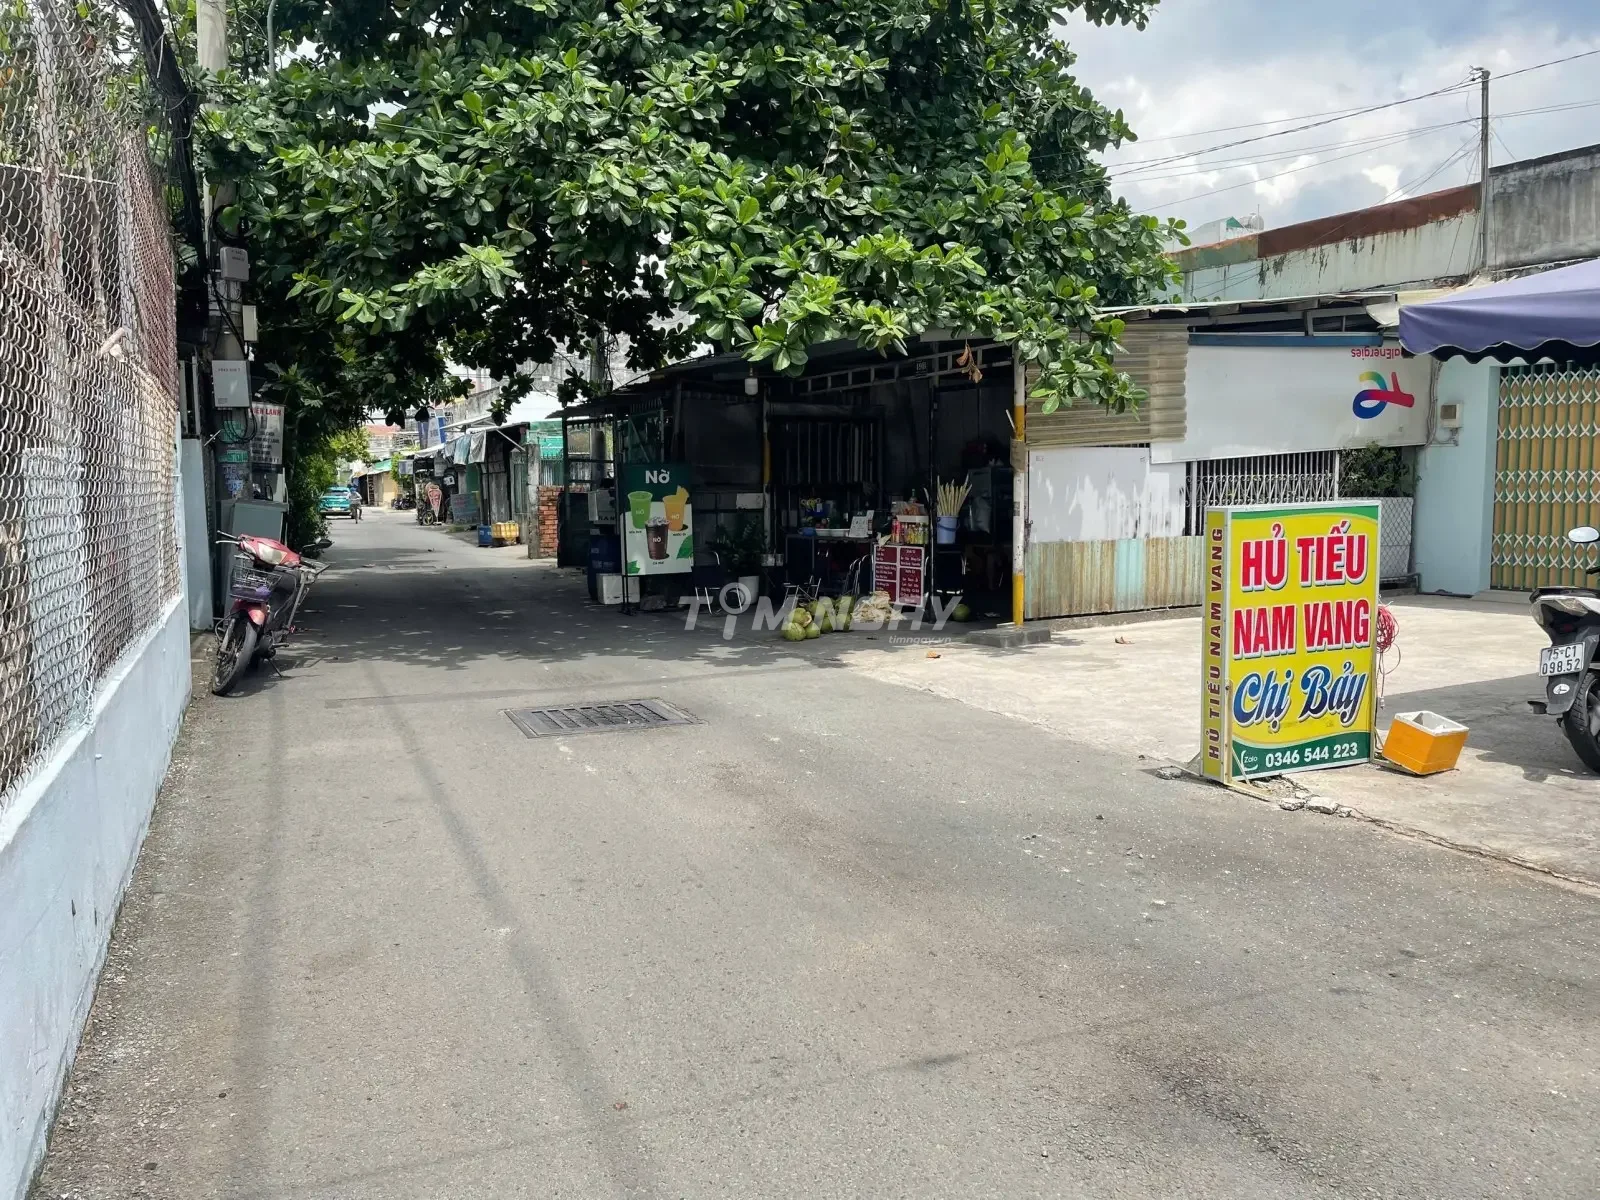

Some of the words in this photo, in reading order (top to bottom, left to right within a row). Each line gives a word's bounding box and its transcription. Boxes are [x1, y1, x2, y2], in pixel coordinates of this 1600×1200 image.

[645, 469, 670, 484] Nờ
[1211, 528, 1224, 592] VANG
[1240, 522, 1289, 592] HỦ
[1296, 520, 1369, 586] TIẾU
[1209, 602, 1223, 657] NAM
[1233, 604, 1297, 660] NAM
[1303, 598, 1371, 651] VANG
[1542, 658, 1580, 674] 098.52
[1232, 668, 1295, 732] Chị
[1298, 661, 1368, 726] Bảy
[1265, 751, 1300, 768] 0346
[1303, 747, 1331, 762] 544
[1332, 742, 1358, 759] 223
